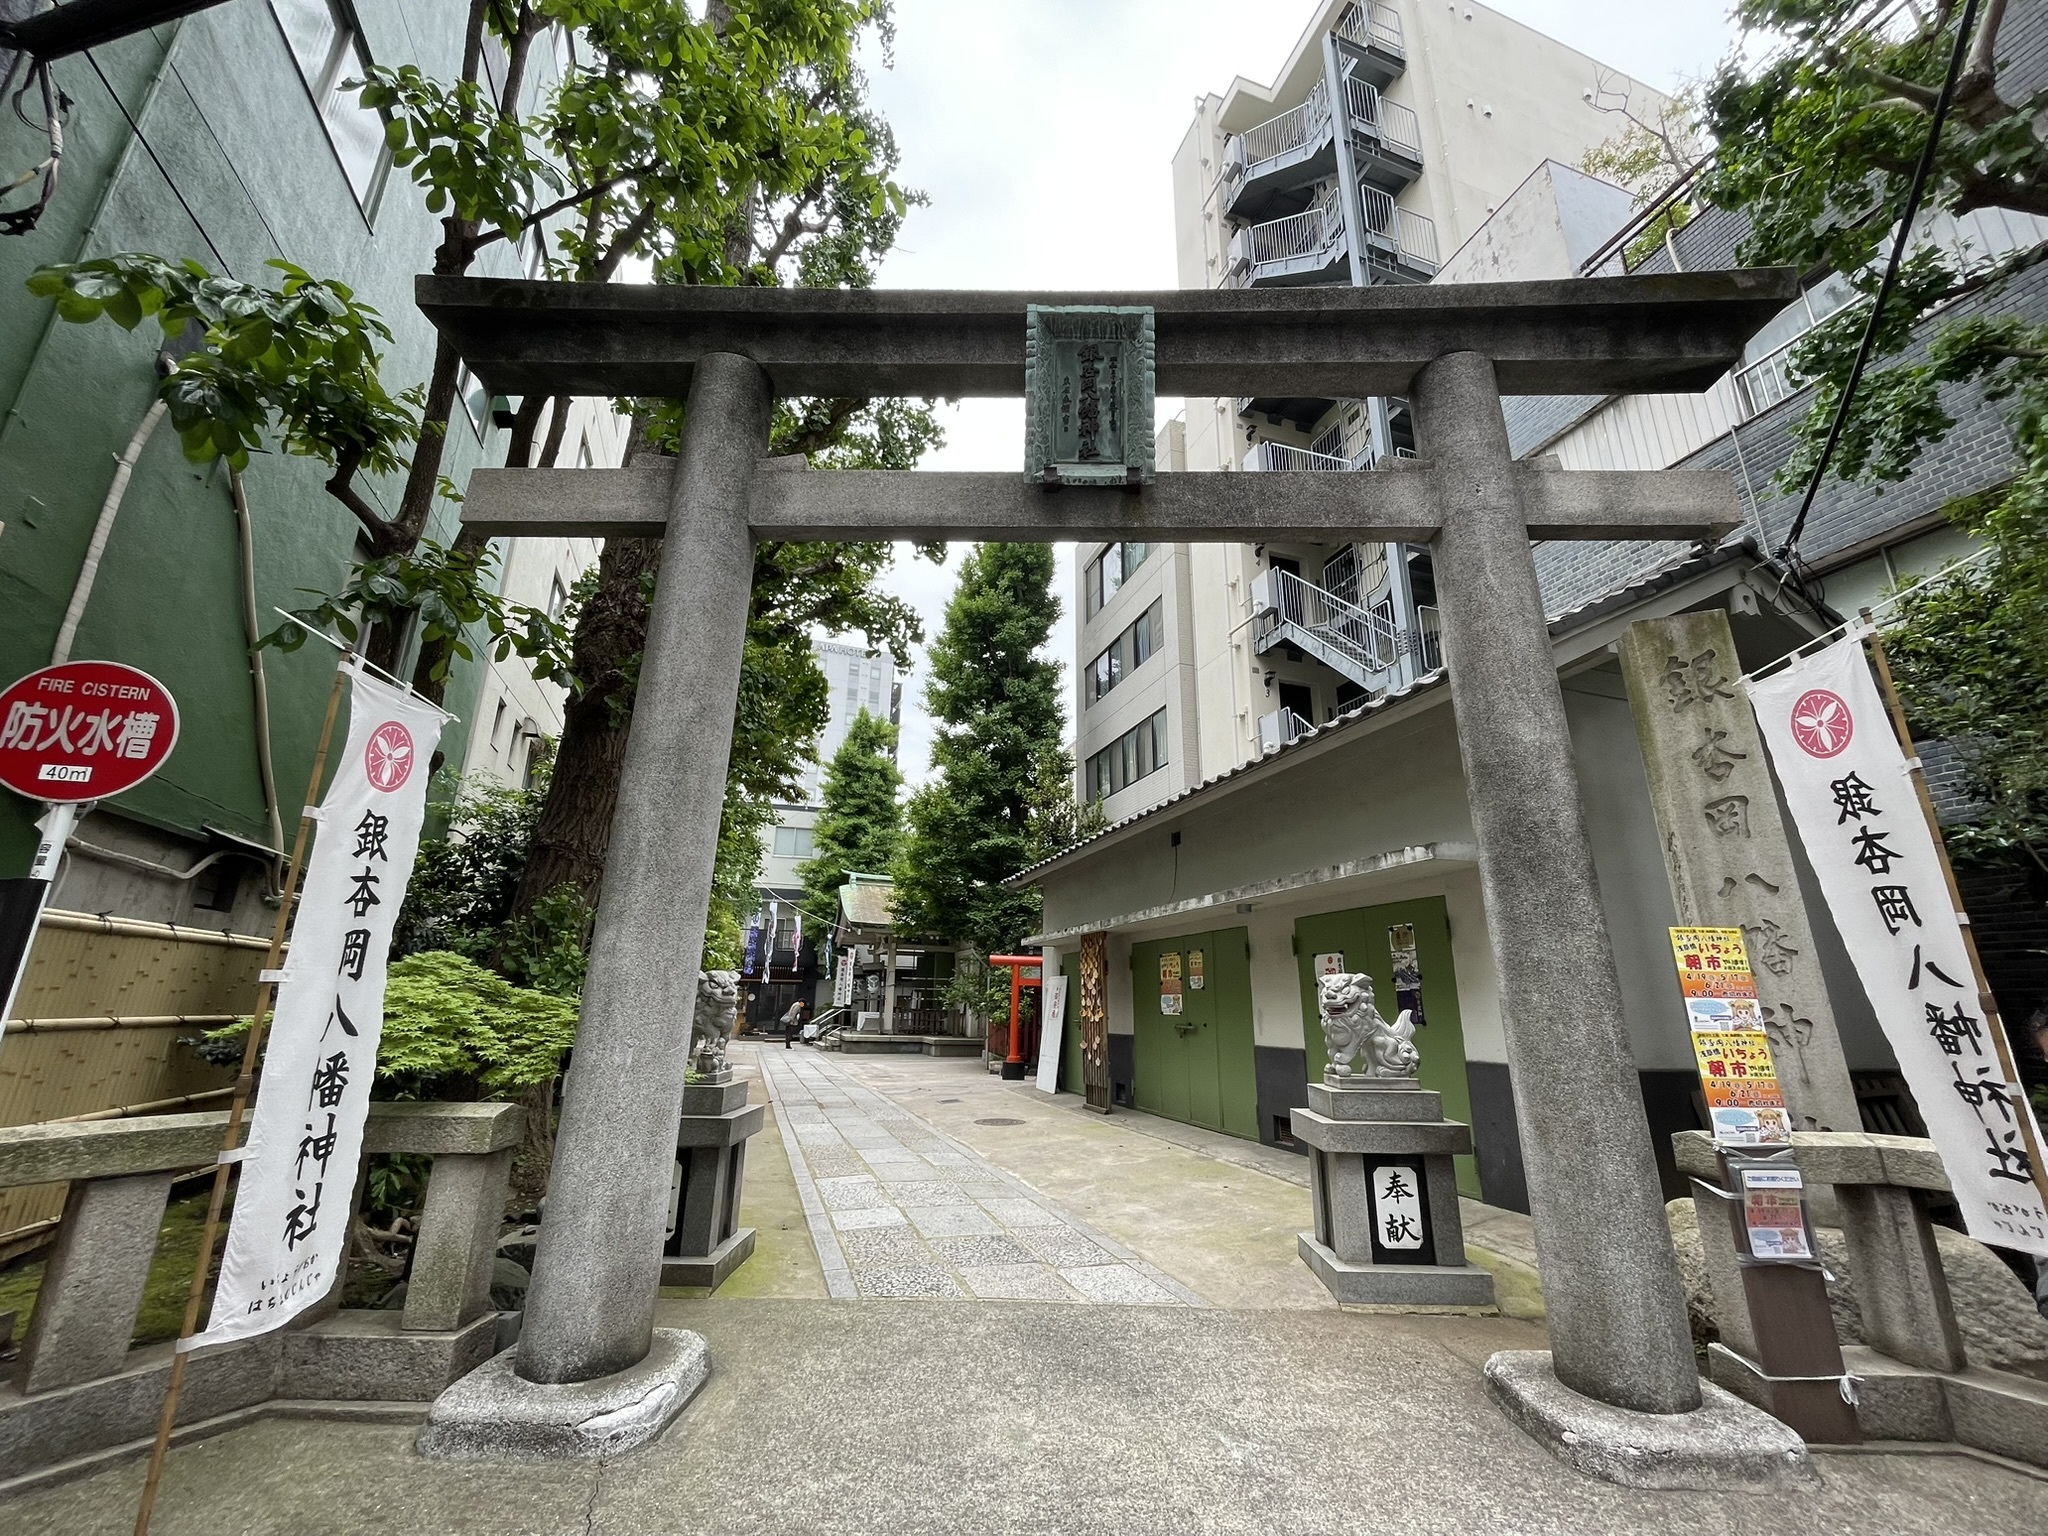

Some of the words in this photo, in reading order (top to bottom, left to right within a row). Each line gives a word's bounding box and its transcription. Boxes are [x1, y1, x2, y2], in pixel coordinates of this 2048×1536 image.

[839, 646, 867, 658] HOTE
[38, 677, 74, 693] FIRE
[81, 681, 151, 701] CISTERN
[1265, 688, 1271, 698] 3
[0, 701, 160, 760] 防火水槽
[1698, 943, 1742, 954] いちょう
[1684, 954, 1721, 970] 朝市
[282, 808, 389, 1253] 銀杏岡八幡神社
[1722, 1048, 1767, 1060] いちょう
[1707, 1060, 1747, 1077] 朝市
[1381, 1170, 1421, 1243] 奉献
